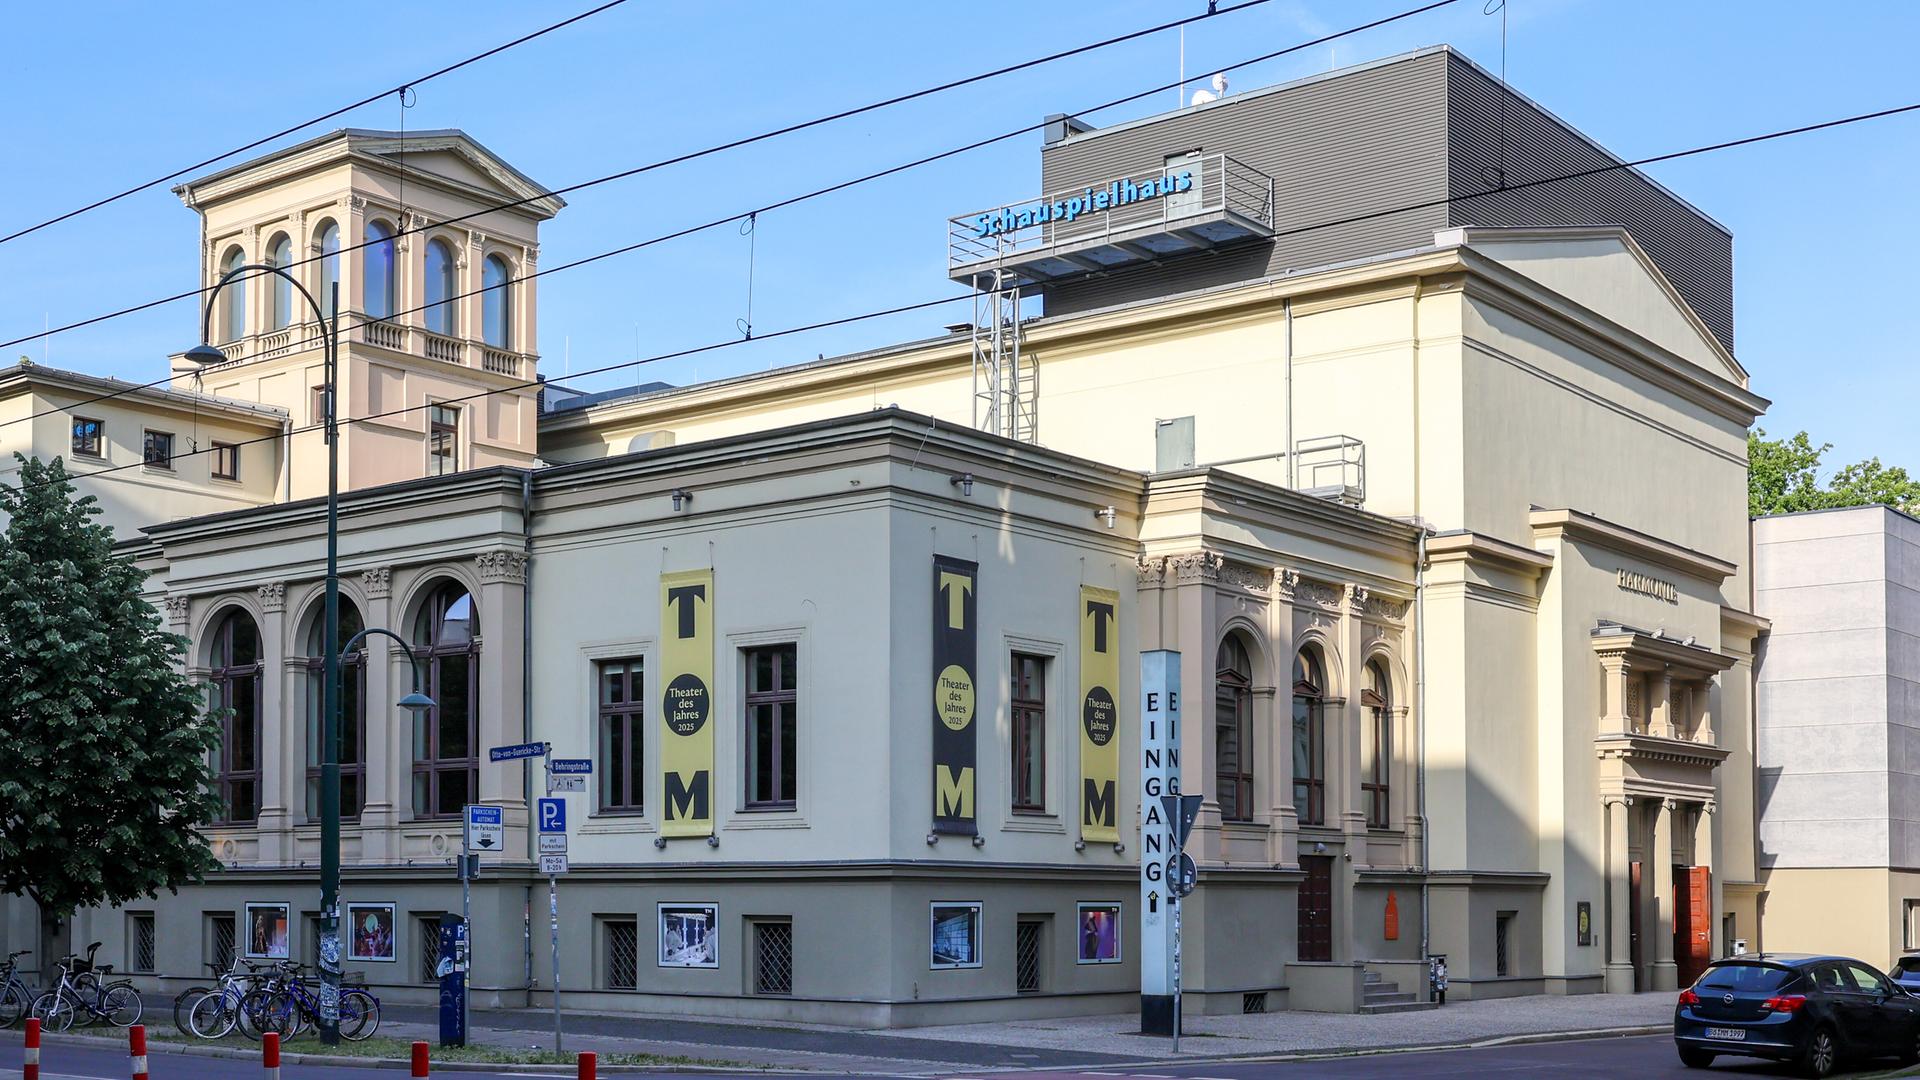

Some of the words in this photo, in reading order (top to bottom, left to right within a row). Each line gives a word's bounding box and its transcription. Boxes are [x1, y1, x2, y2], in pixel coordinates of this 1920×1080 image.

[975, 171, 1192, 238] Schauspielhaus
[1616, 568, 1678, 602] HARMONIE
[940, 571, 972, 630] T
[668, 584, 705, 639] T
[1087, 600, 1114, 653] T
[941, 677, 970, 691] Theater
[669, 687, 703, 698] Theater
[949, 690, 961, 702] des
[678, 698, 694, 709] des
[944, 701, 967, 714] Jahres
[1087, 697, 1112, 710] Theater
[673, 709, 699, 722] Jahres
[949, 716, 963, 725] 2025
[1094, 709, 1105, 720] des
[678, 723, 694, 731] 2025
[1090, 719, 1109, 731] Jahres
[1094, 733, 1106, 742] 2025
[555, 761, 590, 773] Behringstraße
[936, 764, 974, 818] M
[1145, 693, 1161, 881] EINGANG
[664, 770, 709, 821] M
[1084, 778, 1116, 828] M
[543, 803, 557, 828] P
